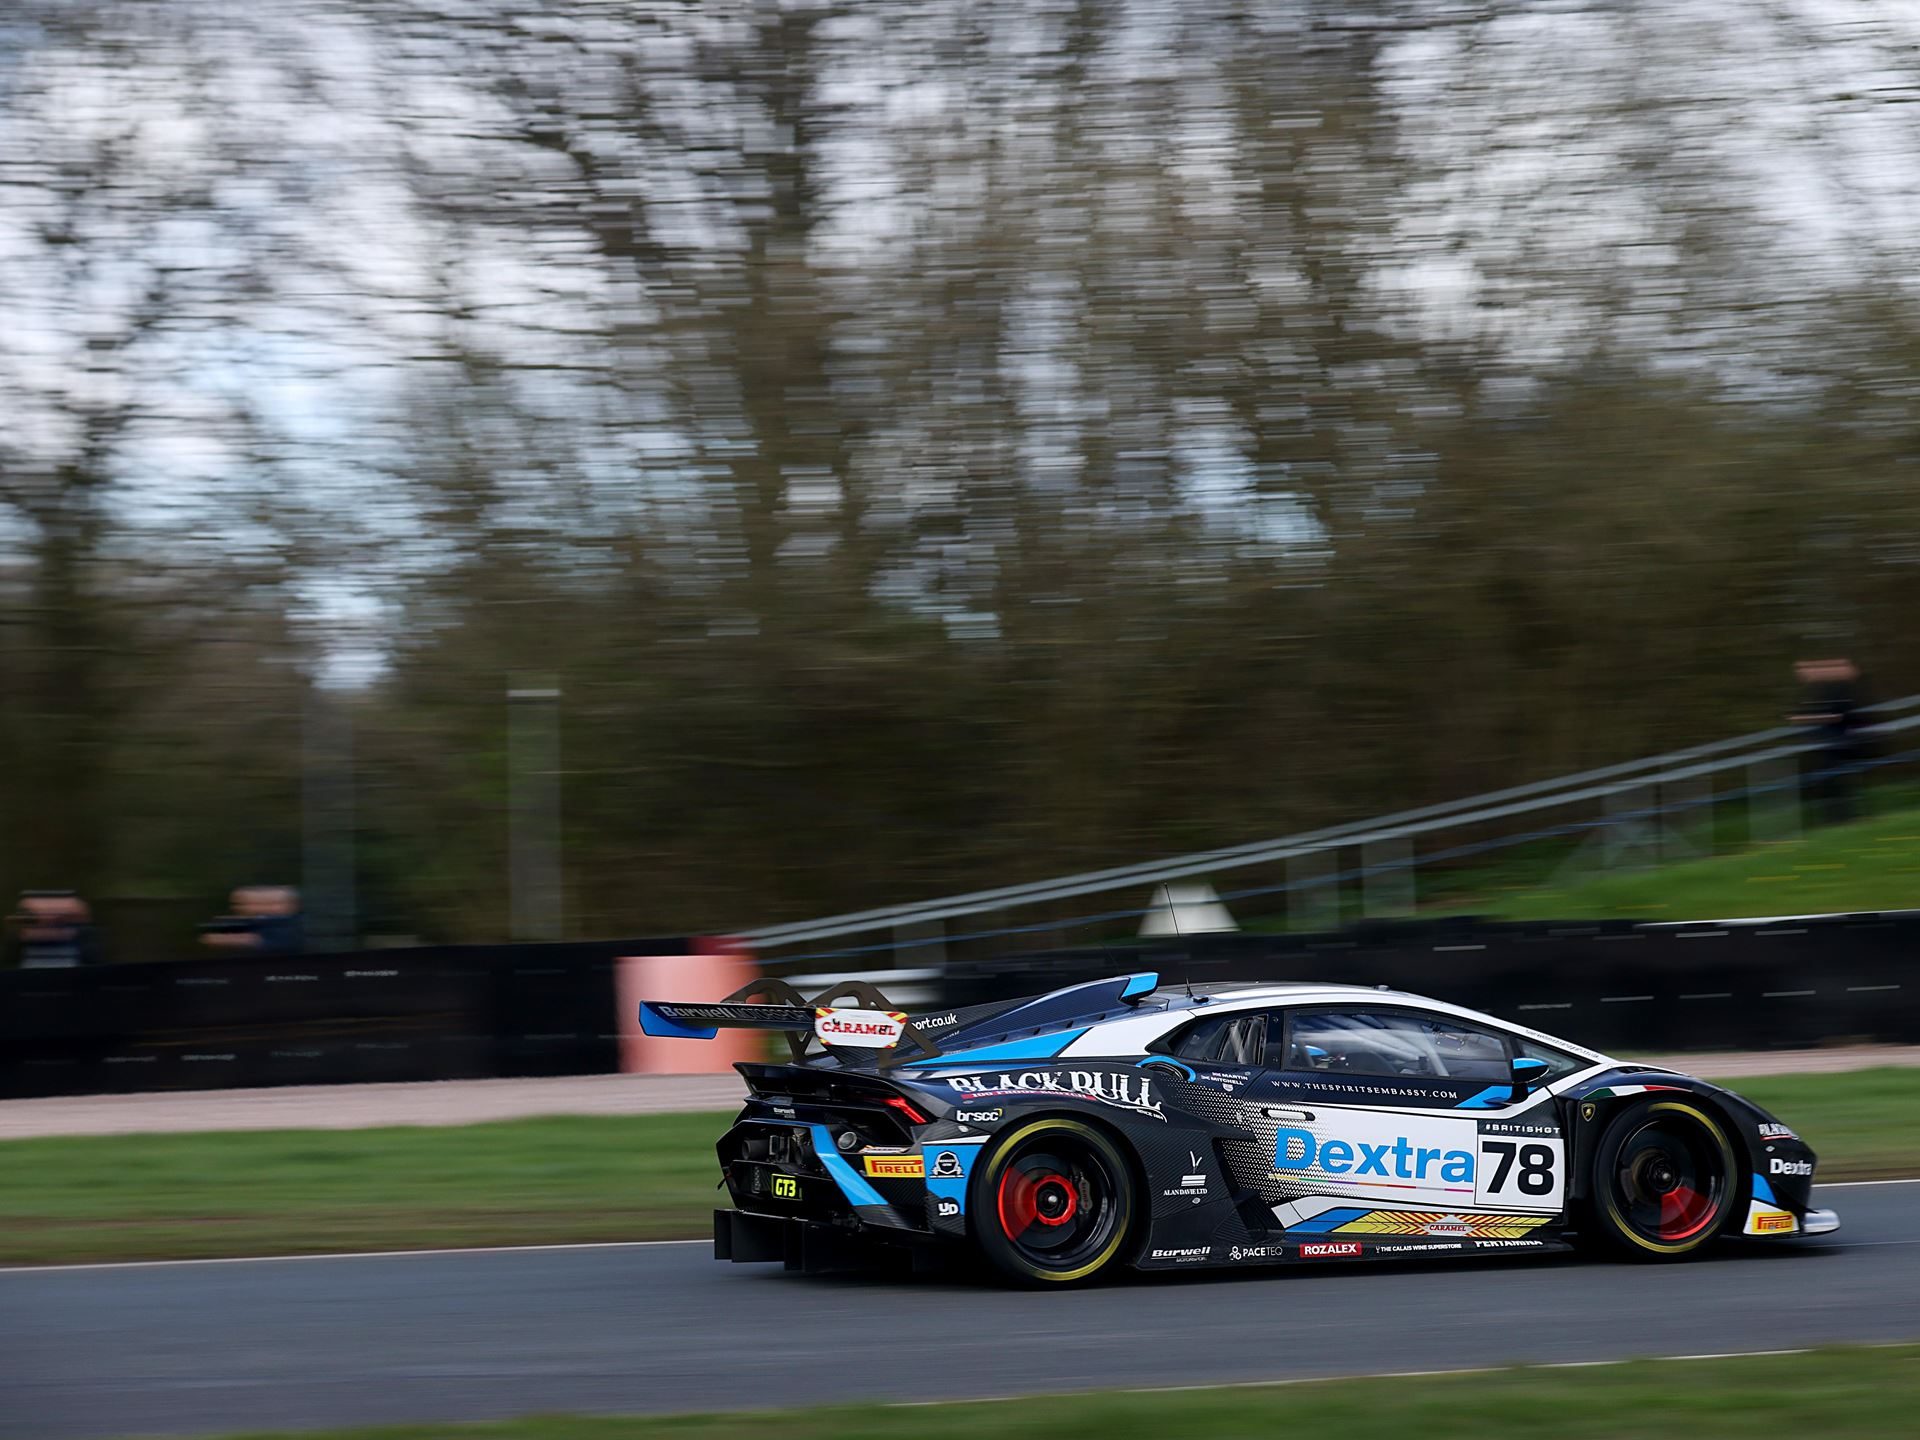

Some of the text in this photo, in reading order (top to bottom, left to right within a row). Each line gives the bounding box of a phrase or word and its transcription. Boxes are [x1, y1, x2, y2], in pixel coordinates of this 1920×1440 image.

[658, 1006, 736, 1018] Barwell
[822, 1021, 896, 1036] CARAMEL
[911, 1013, 957, 1031] ort.co.uk
[1210, 1076, 1245, 1086] MITCHELL
[1221, 1073, 1249, 1081] MARTIN
[946, 1071, 1162, 1111] BLACK BULL
[1271, 1080, 1458, 1099] WWW.THESPIRITSEMBASSY.COM
[956, 1109, 1000, 1122] brscc
[1485, 1123, 1561, 1134] #BRITISHGT
[1274, 1127, 1475, 1183] Dextra
[871, 1159, 924, 1174] PIRELLI
[1482, 1140, 1555, 1196] 78
[1769, 1158, 1812, 1176] Dextra
[775, 1178, 797, 1197] GT3
[1429, 1224, 1466, 1232] CARAMEL
[1151, 1246, 1211, 1257] Barwell
[1243, 1246, 1283, 1257] PACETEQ
[1304, 1243, 1357, 1255] ROZALEX
